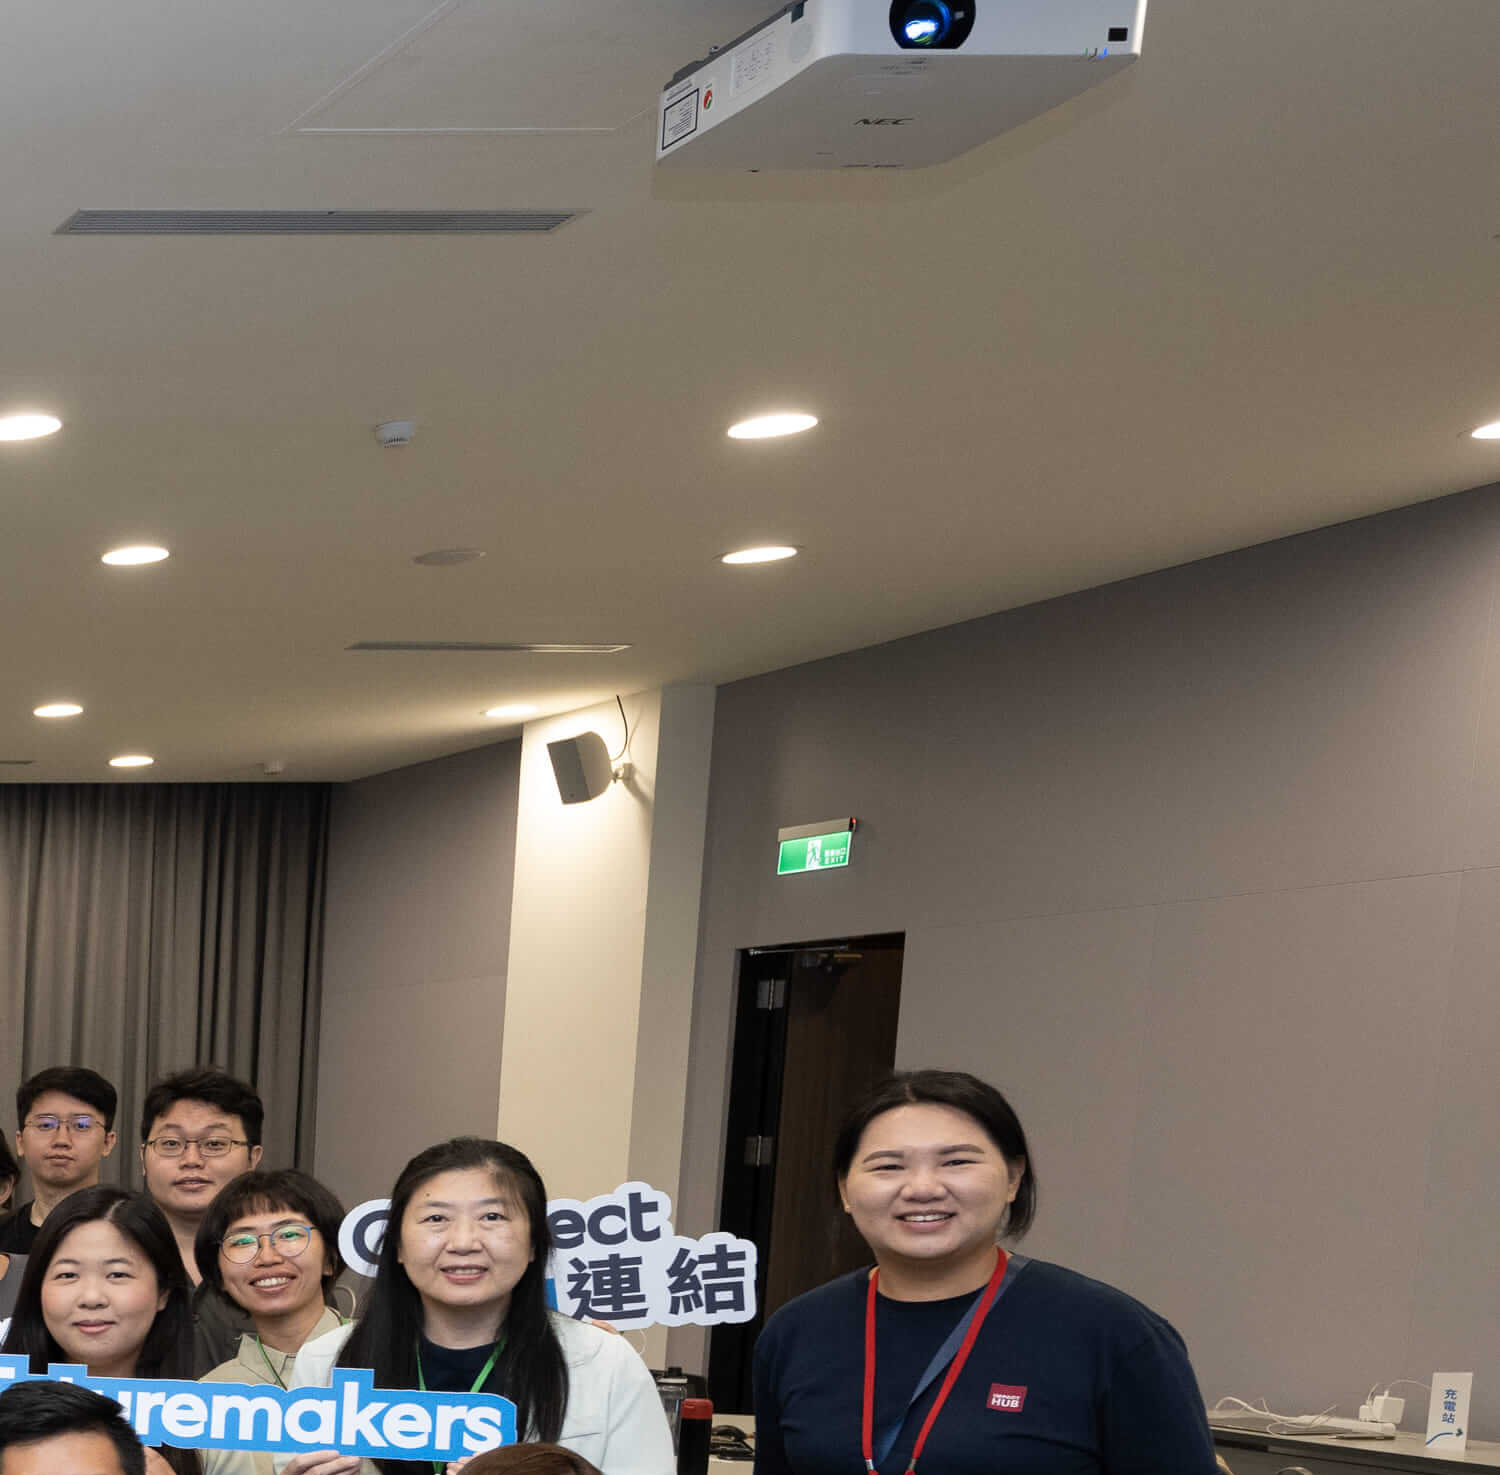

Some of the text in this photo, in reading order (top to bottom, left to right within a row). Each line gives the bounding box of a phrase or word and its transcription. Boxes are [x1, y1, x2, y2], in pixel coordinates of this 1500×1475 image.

[567, 1243, 746, 1321] 連結
[991, 1397, 1019, 1408] HUB
[1442, 1388, 1457, 1424] 充電站
